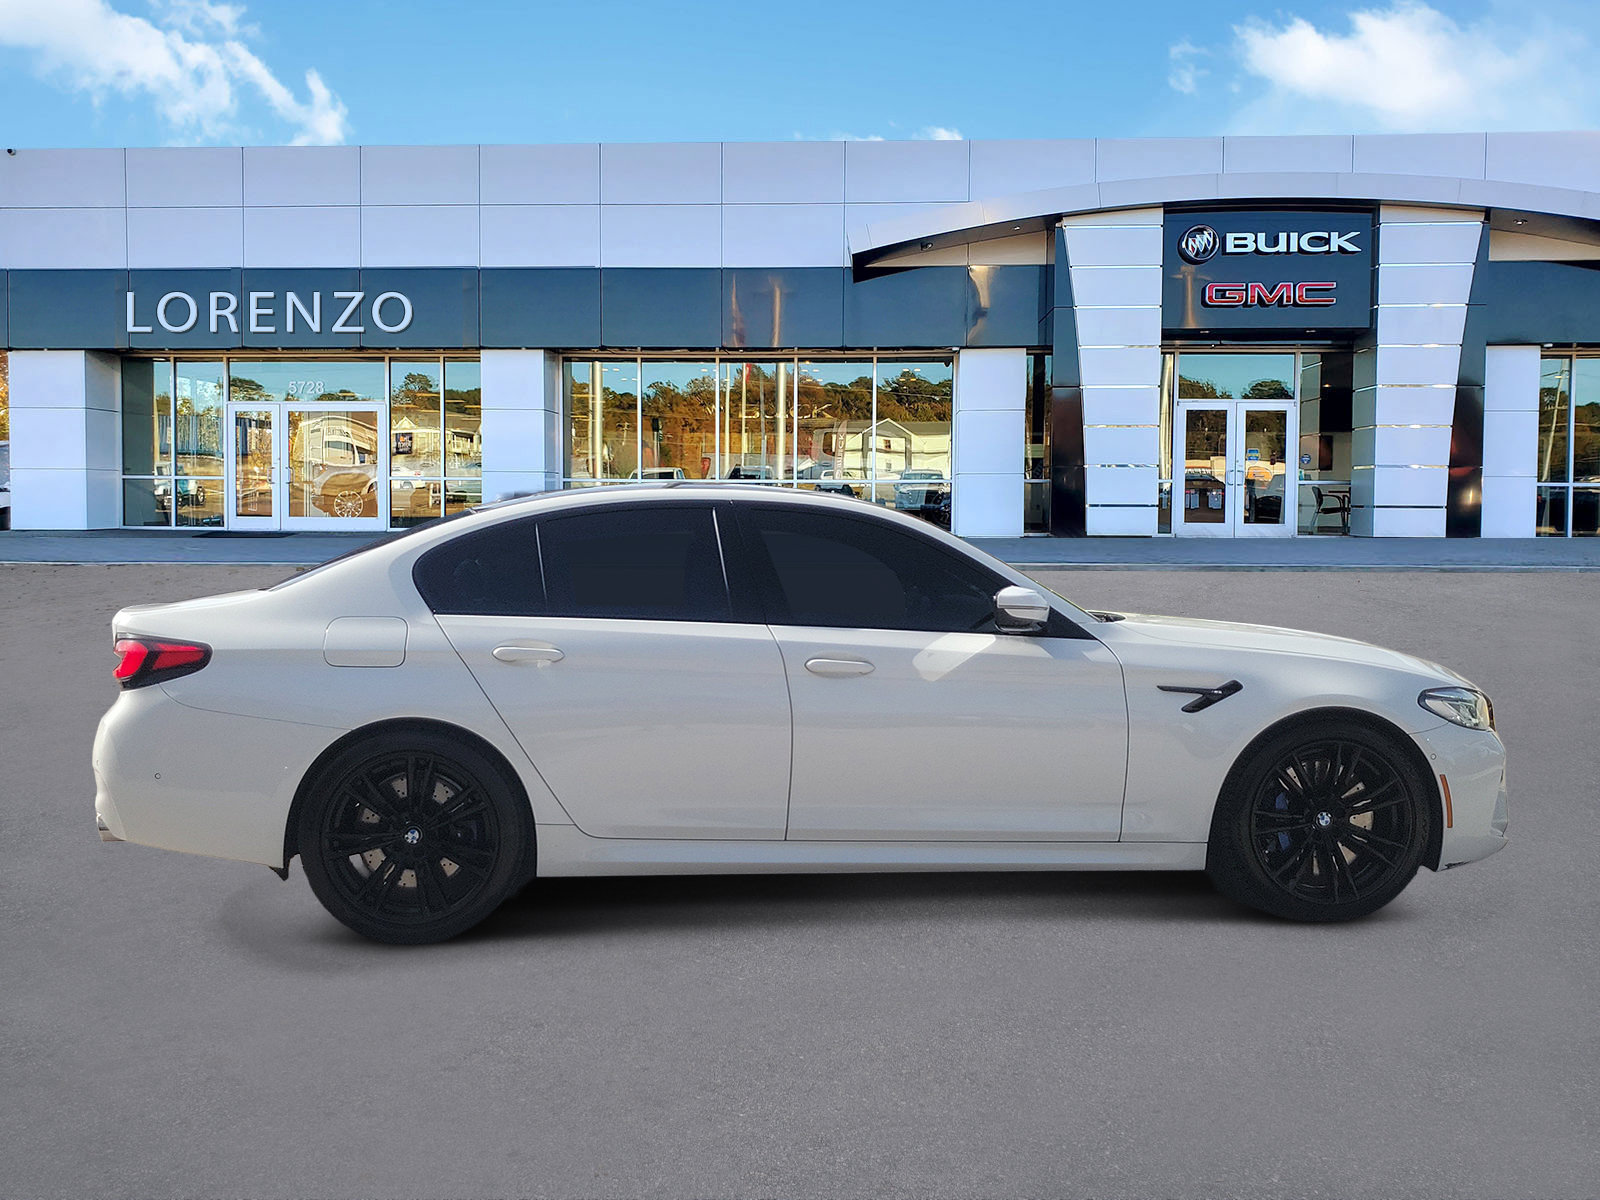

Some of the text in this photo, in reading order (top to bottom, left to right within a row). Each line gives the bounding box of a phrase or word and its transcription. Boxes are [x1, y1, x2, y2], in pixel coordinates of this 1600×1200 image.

[1225, 231, 1362, 252] BUICK
[1206, 282, 1337, 305] GMC
[126, 291, 414, 333] LORENZO
[288, 380, 325, 394] 5728
